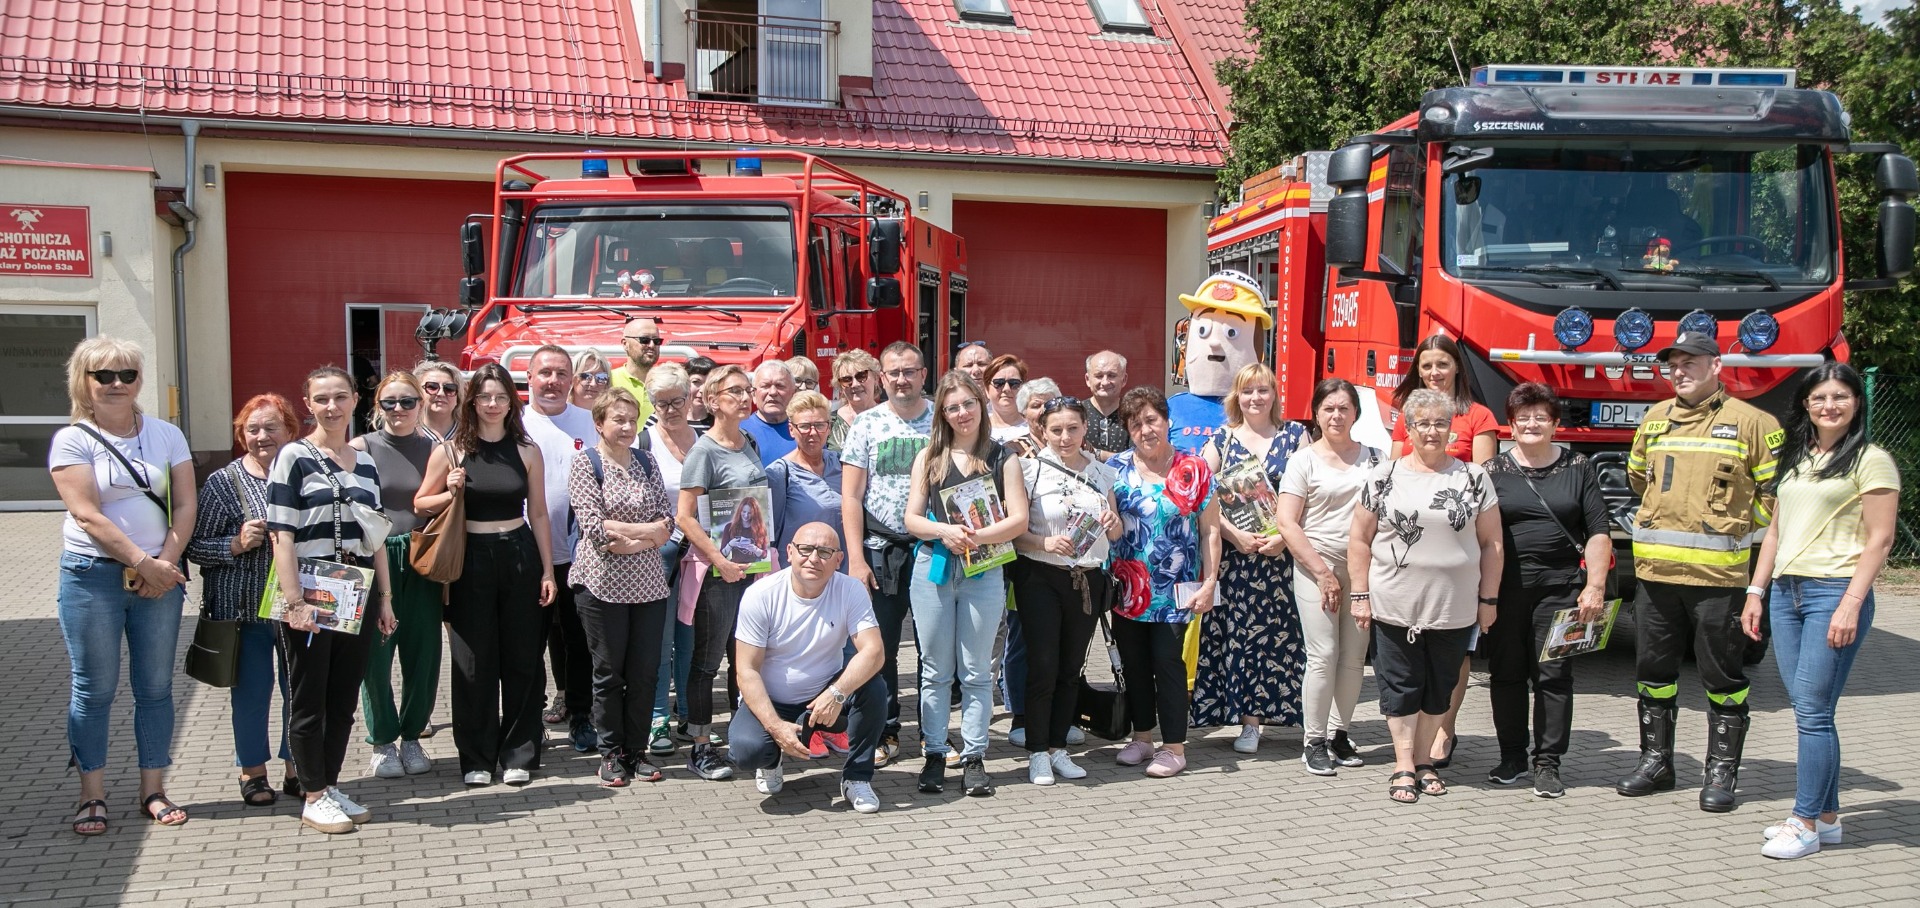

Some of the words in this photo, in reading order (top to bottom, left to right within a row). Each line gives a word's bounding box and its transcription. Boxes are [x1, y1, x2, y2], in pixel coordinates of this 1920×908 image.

[1482, 120, 1544, 131] SZCZĘŚNIAK
[22, 246, 85, 261] POŻARNA
[1388, 355, 1398, 370] OSP
[1601, 405, 1634, 423] DPL
[1768, 432, 1783, 446] OSP
